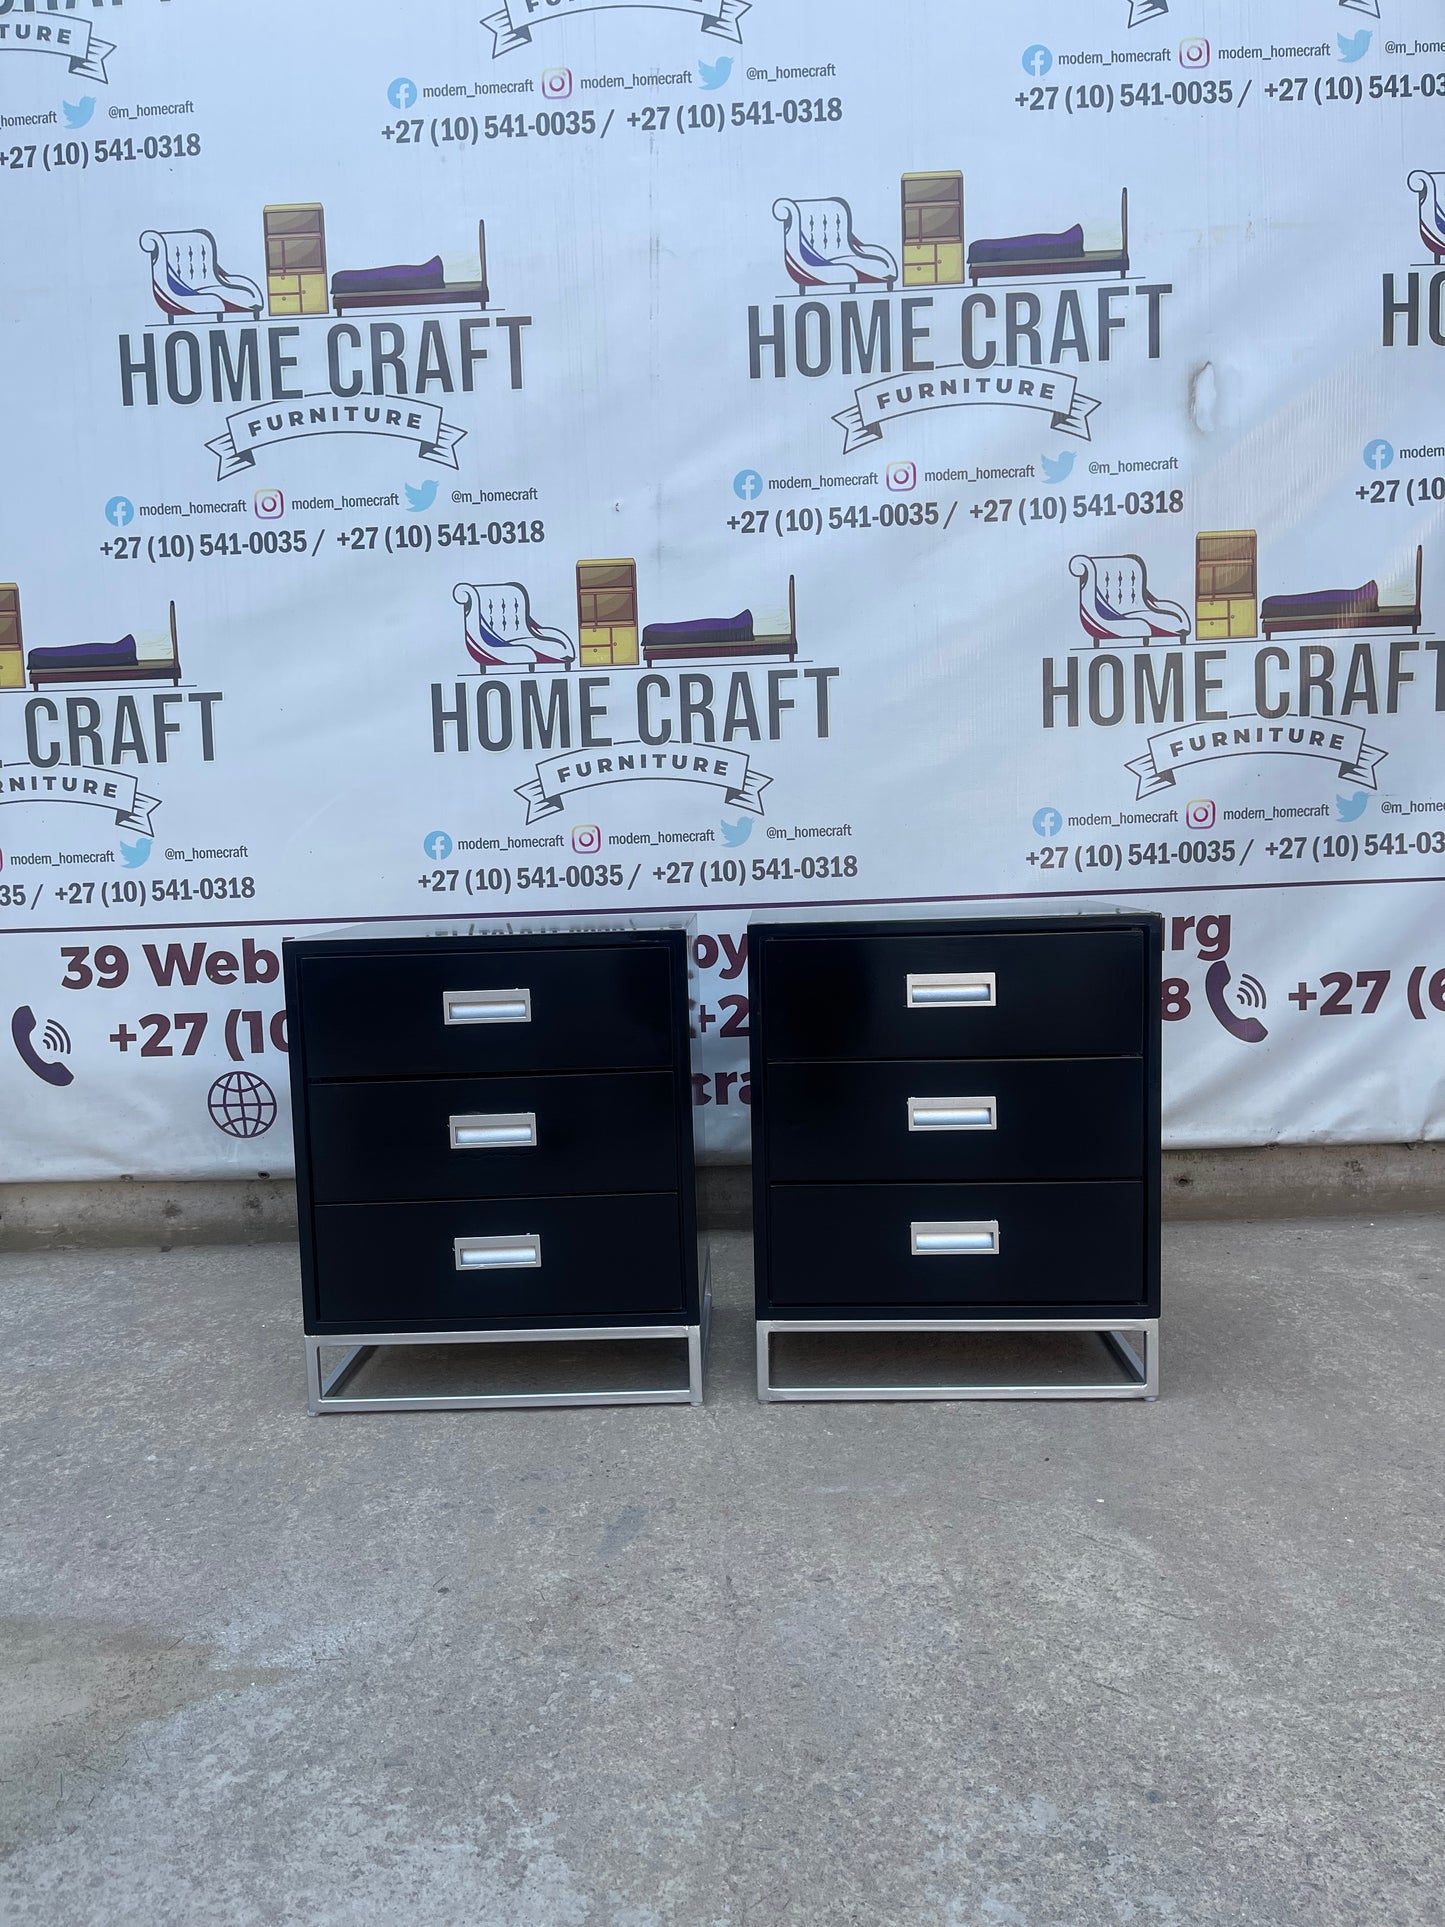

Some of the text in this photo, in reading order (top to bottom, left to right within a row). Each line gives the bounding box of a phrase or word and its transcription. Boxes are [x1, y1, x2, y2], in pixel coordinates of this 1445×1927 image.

[747, 63, 836, 82] @m_homecraft
[109, 100, 194, 120] @m_homecraft
[748, 284, 1172, 379] HOME CRAFT
[119, 316, 532, 406] HOME CRAFT
[877, 377, 1056, 410] FURNITURE
[248, 406, 423, 438] FURNITURE
[1089, 457, 1178, 475] @m_homecraft
[451, 487, 538, 505] @m_homecraft
[1043, 641, 1445, 728] HOME CRAFT
[431, 667, 839, 753] HOME CRAFT
[24, 692, 223, 768] CRAFT
[1170, 728, 1345, 757] FURNITURE
[557, 748, 729, 784] FURNITURE
[1381, 800, 1445, 815] @m_home
[767, 824, 852, 841] @m_homecraft
[165, 845, 248, 864] @m_homecraft
[60, 945, 129, 990] 39
[142, 938, 279, 987] Web
[1288, 970, 1391, 1016] +27
[110, 1012, 208, 1057] +27
